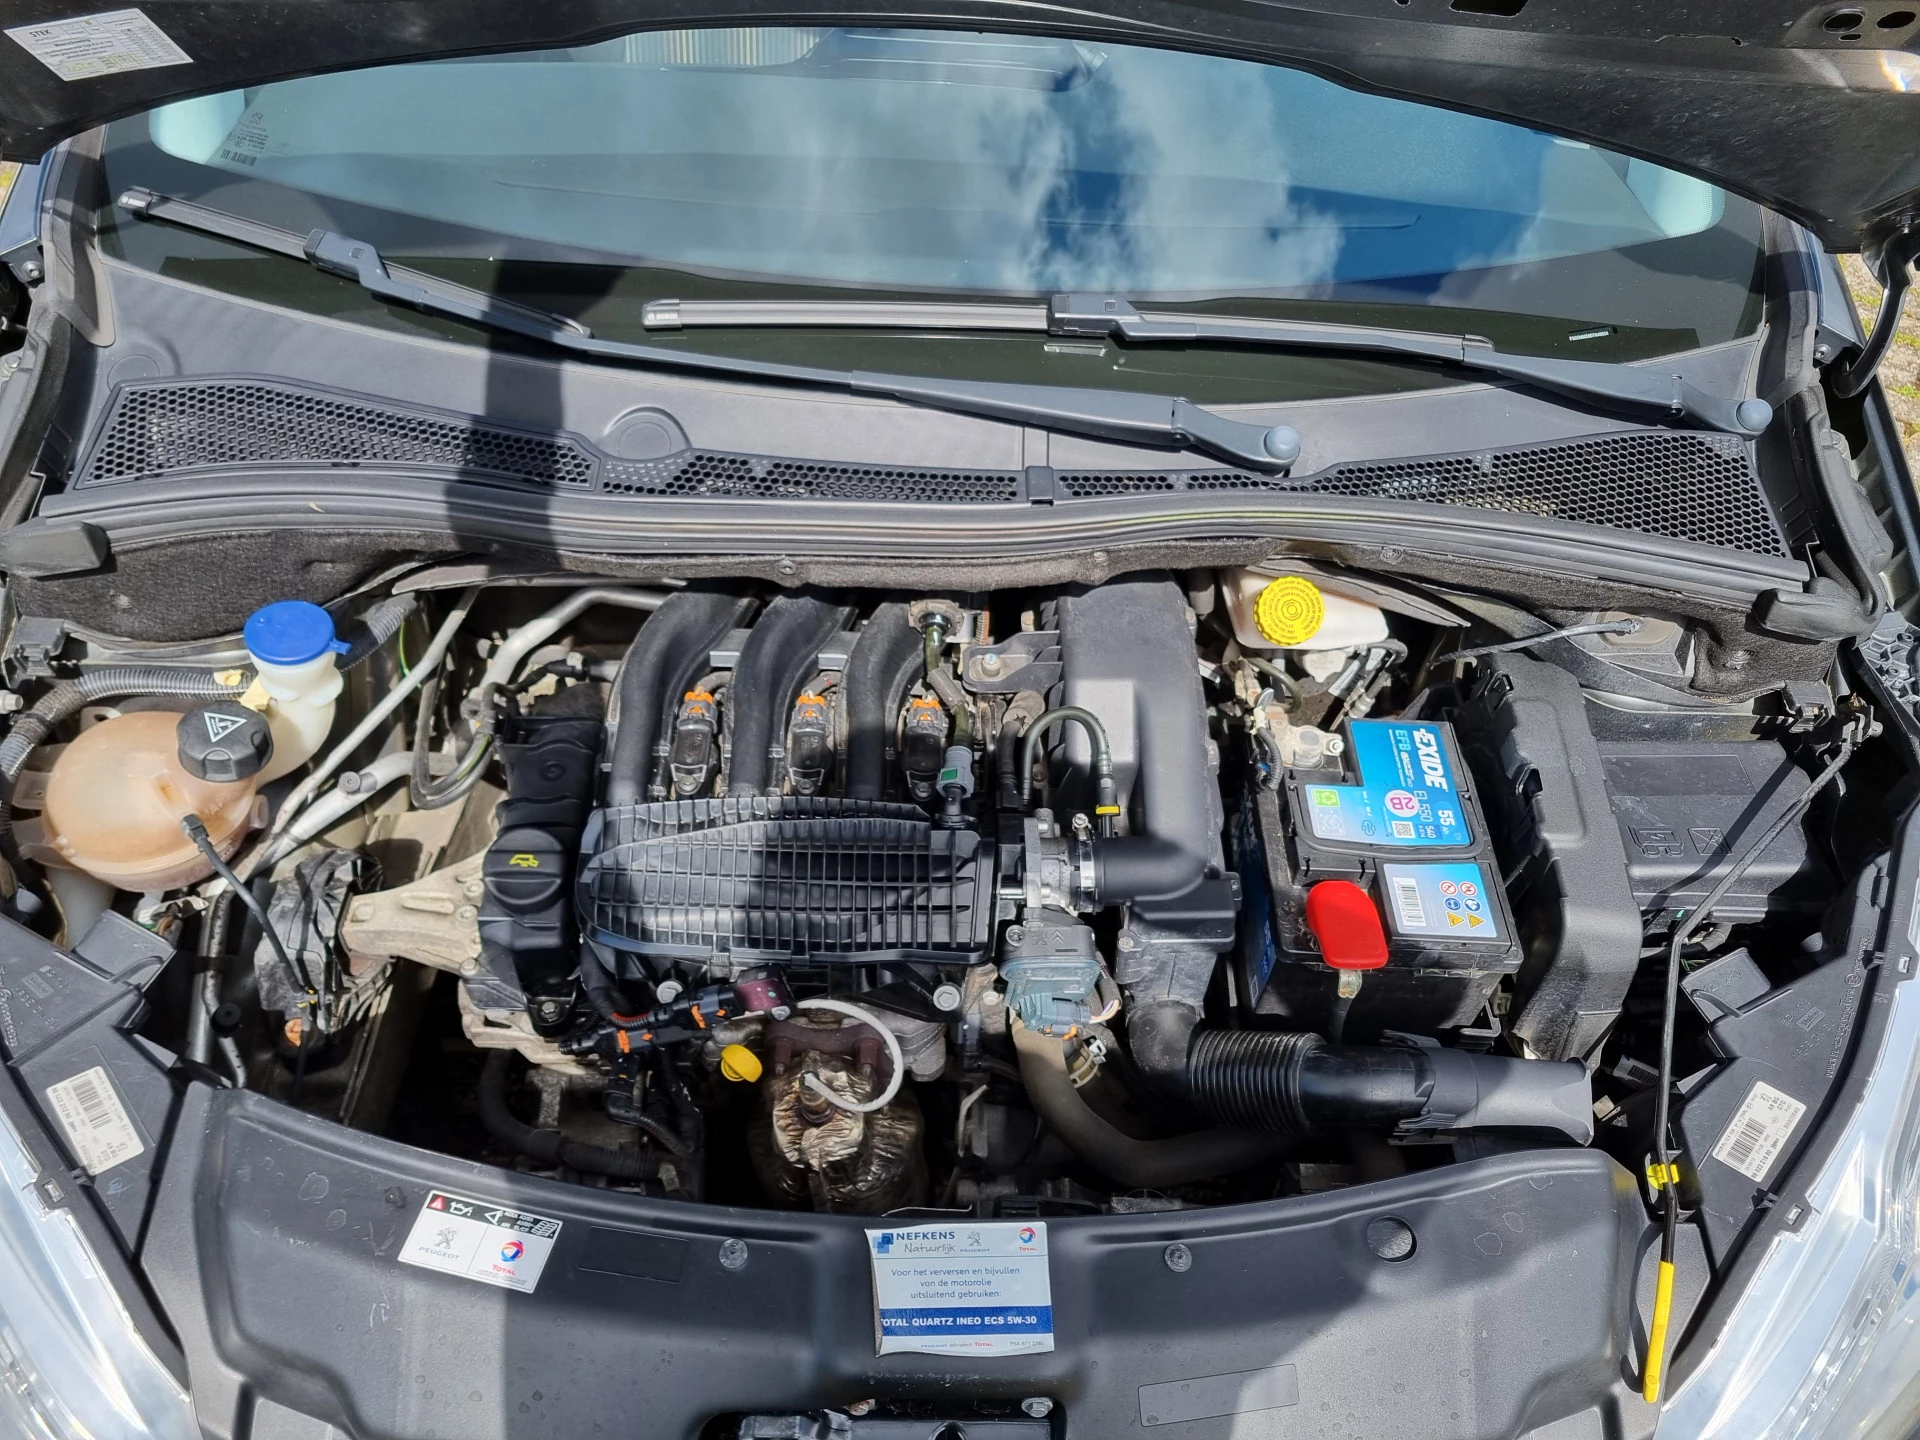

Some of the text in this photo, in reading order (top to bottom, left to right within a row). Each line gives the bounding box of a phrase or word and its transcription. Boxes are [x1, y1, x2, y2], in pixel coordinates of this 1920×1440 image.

[29, 29, 53, 38] STEK
[1395, 730, 1411, 750] EFB
[1413, 729, 1447, 790] EXIDE
[1390, 796, 1415, 811] 2B
[1418, 804, 1433, 822] 550
[1438, 810, 1456, 834] 55 Ah
[1425, 825, 1435, 838] 540
[896, 1231, 955, 1241] NEFKENS
[418, 1246, 460, 1260] PEUGEOT
[904, 1243, 955, 1254] Natuurlijk
[492, 1264, 516, 1275] TOTAL
[985, 1267, 1020, 1276] bijvullen
[958, 1290, 1002, 1300] gebruiken:
[912, 1317, 954, 1325] QUARTZ
[956, 1317, 981, 1325] INEO
